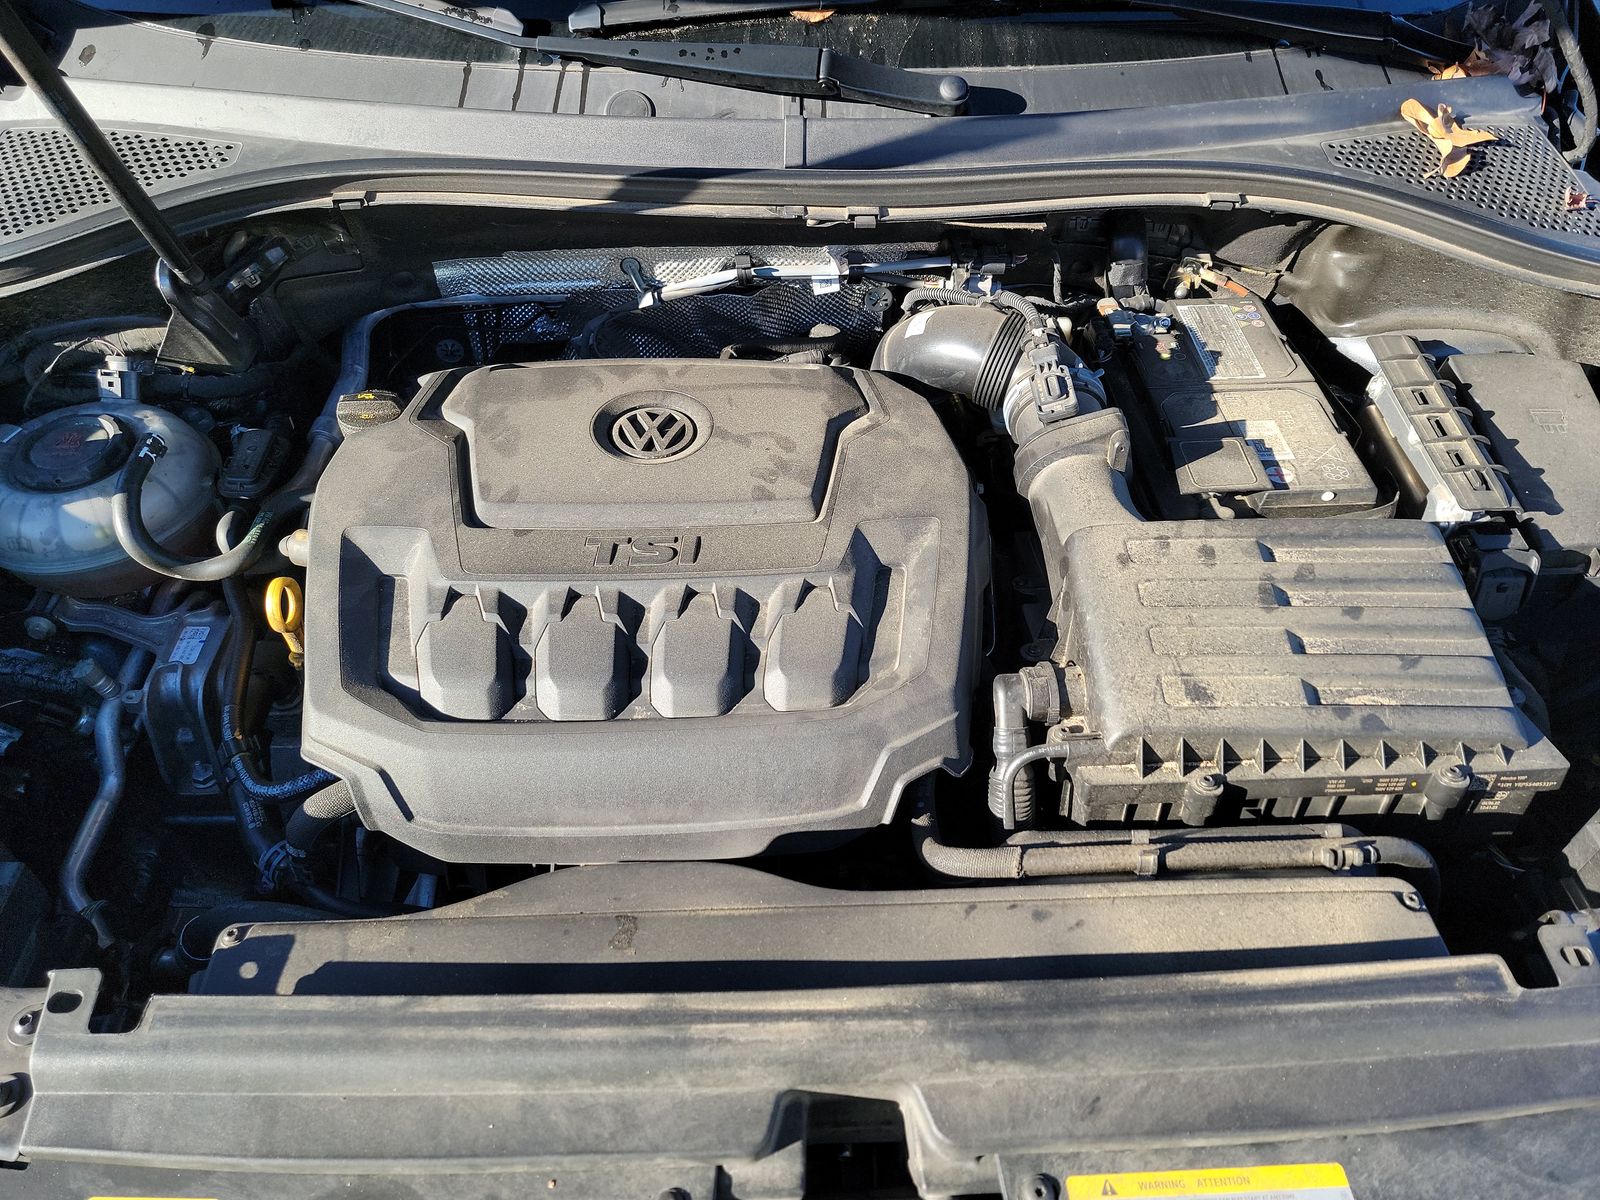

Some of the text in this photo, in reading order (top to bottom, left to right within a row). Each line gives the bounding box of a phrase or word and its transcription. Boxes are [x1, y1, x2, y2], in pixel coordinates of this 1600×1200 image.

[614, 408, 692, 458] VW
[584, 535, 702, 566] TSI
[1137, 1175, 1251, 1191] WARNING ATTENTION
